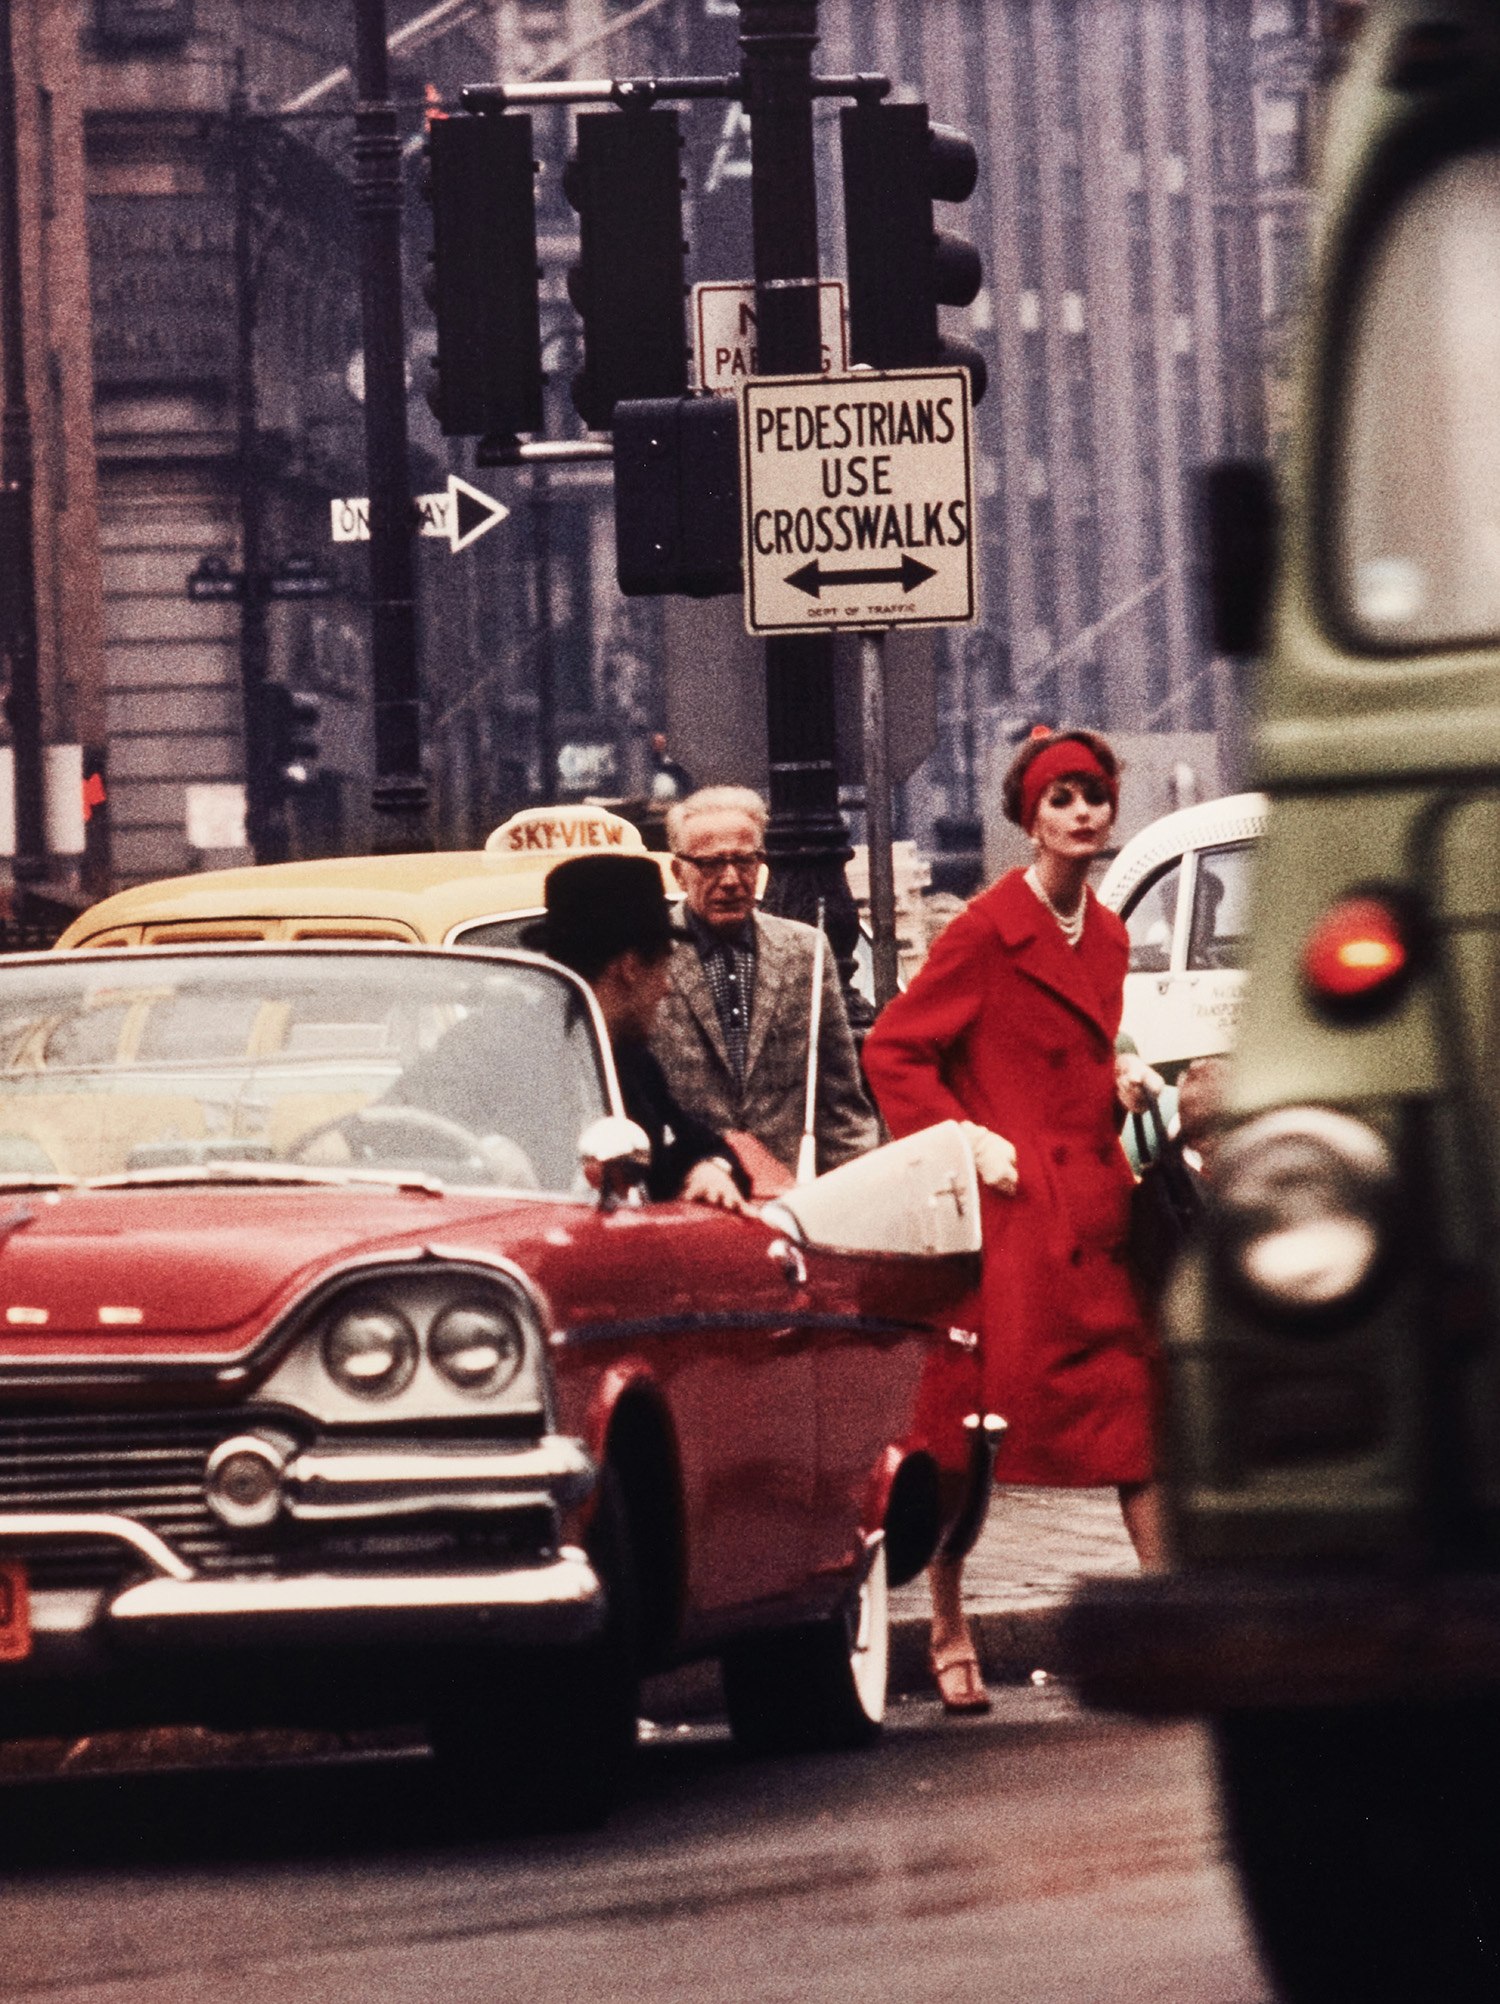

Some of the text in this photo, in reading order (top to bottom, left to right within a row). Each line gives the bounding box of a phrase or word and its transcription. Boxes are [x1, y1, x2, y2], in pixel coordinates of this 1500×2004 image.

[738, 302, 758, 336] N
[756, 398, 955, 452] PEDESTRIANS
[822, 455, 892, 498] USE
[340, 504, 371, 538] ON
[754, 500, 966, 554] CROSSWALKS
[844, 606, 859, 616] OF
[867, 603, 916, 614] TRAFFIC
